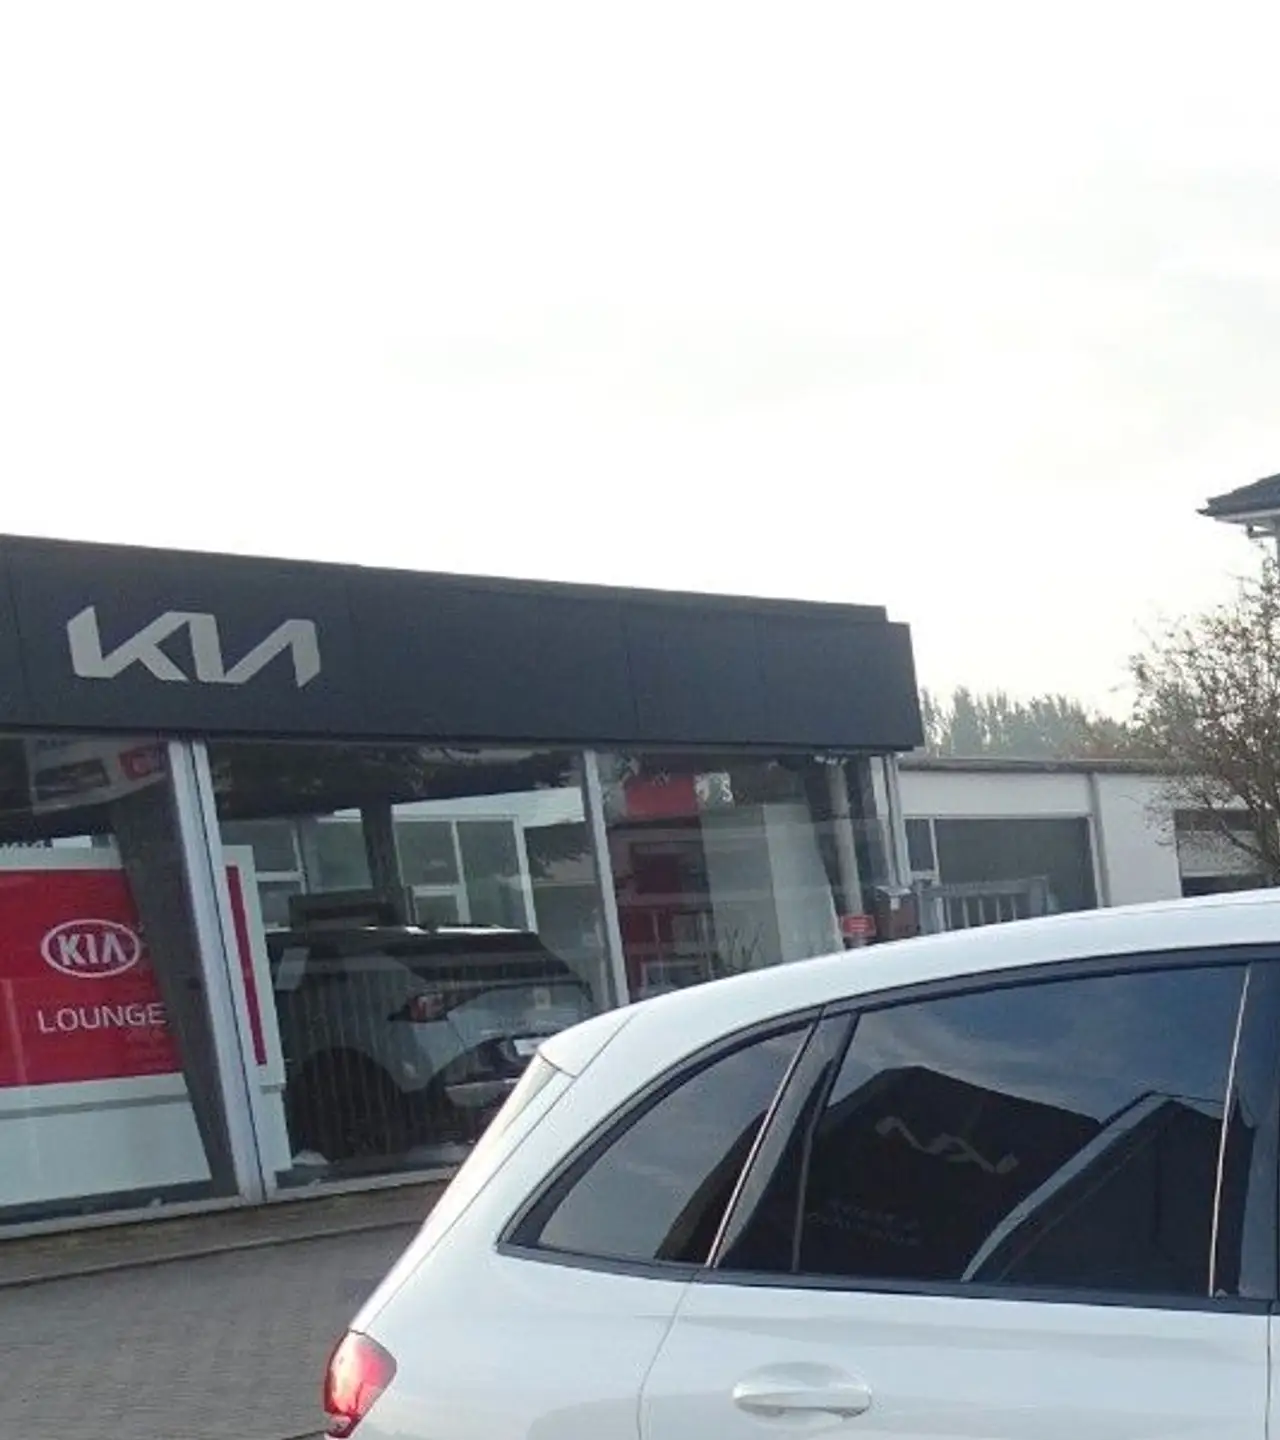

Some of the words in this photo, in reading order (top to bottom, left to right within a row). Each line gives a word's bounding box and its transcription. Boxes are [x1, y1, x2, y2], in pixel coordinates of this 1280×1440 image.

[65, 605, 322, 689] KIA
[56, 931, 127, 967] KIA
[37, 1002, 167, 1034] LOUNGE
